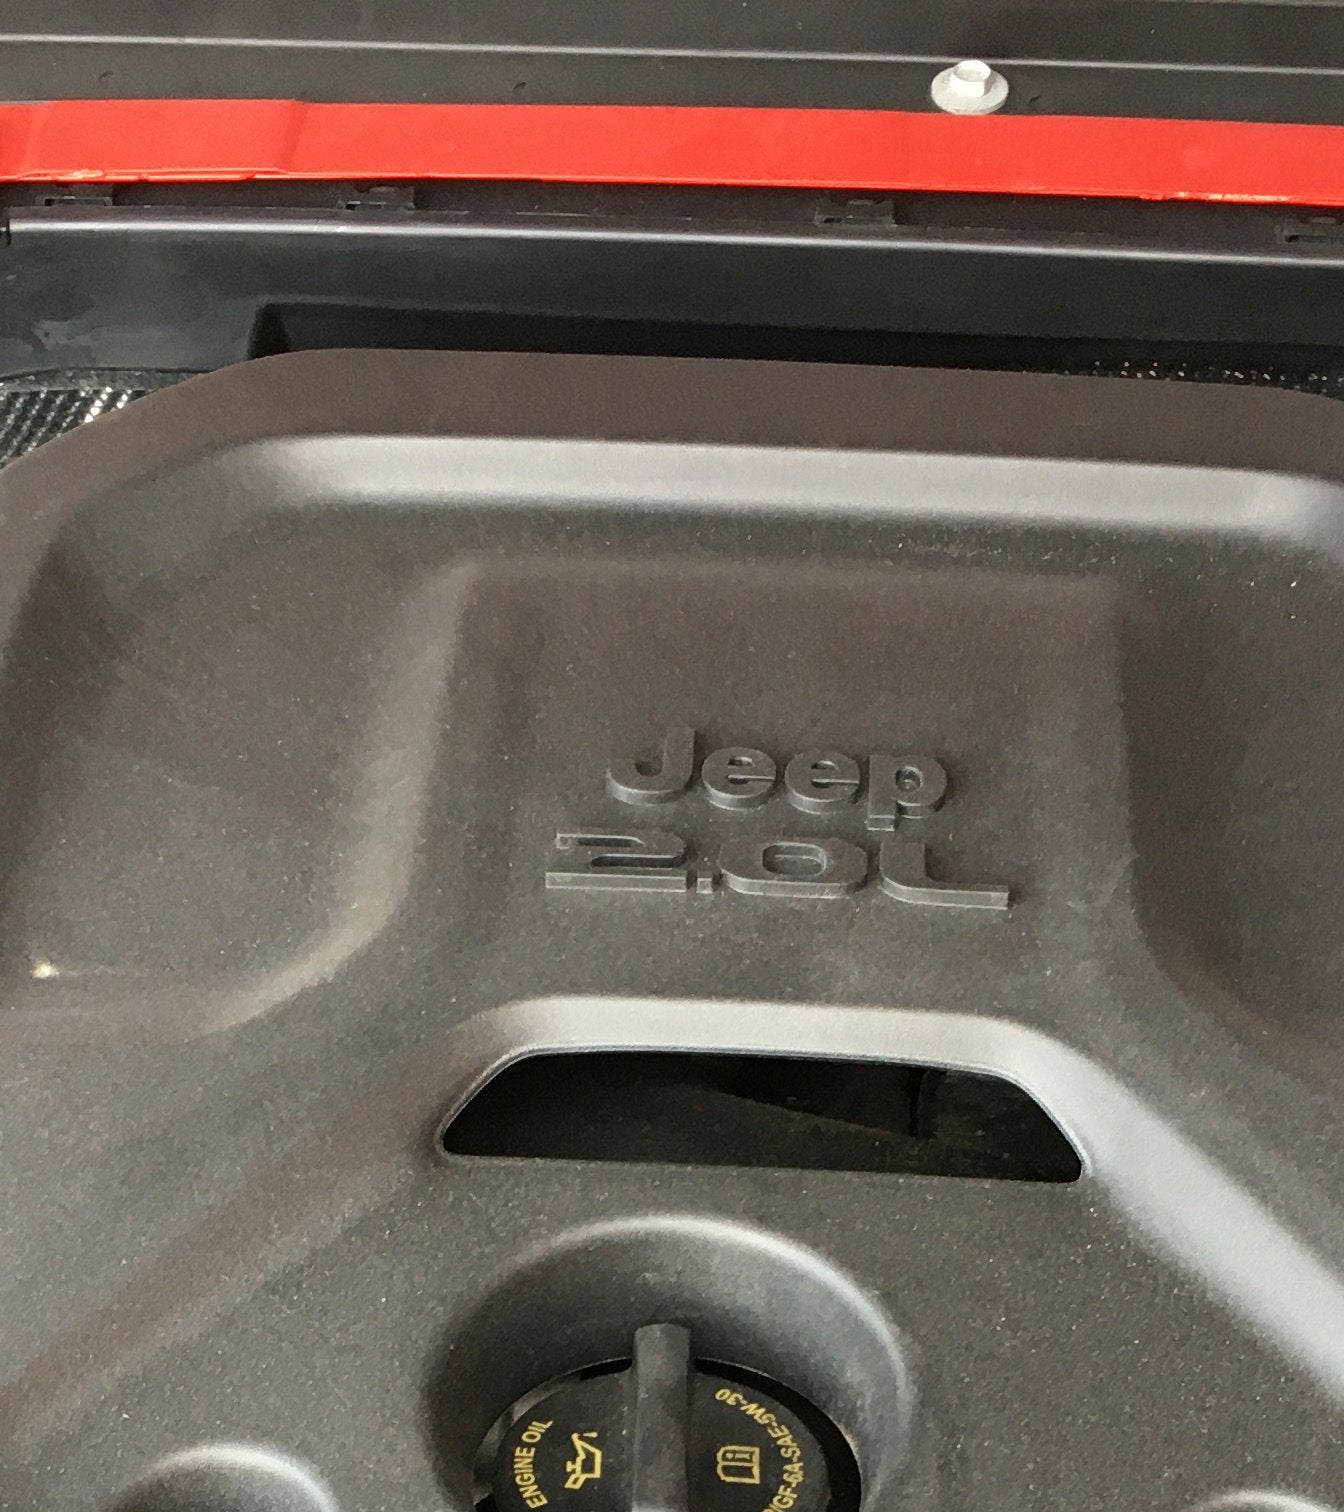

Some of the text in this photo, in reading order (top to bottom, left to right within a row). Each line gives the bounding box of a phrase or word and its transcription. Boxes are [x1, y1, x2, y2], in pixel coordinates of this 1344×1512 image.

[605, 724, 949, 831] Jeep
[544, 828, 1010, 911] 2.0L
[513, 1420, 554, 1509] ENGINE OIL
